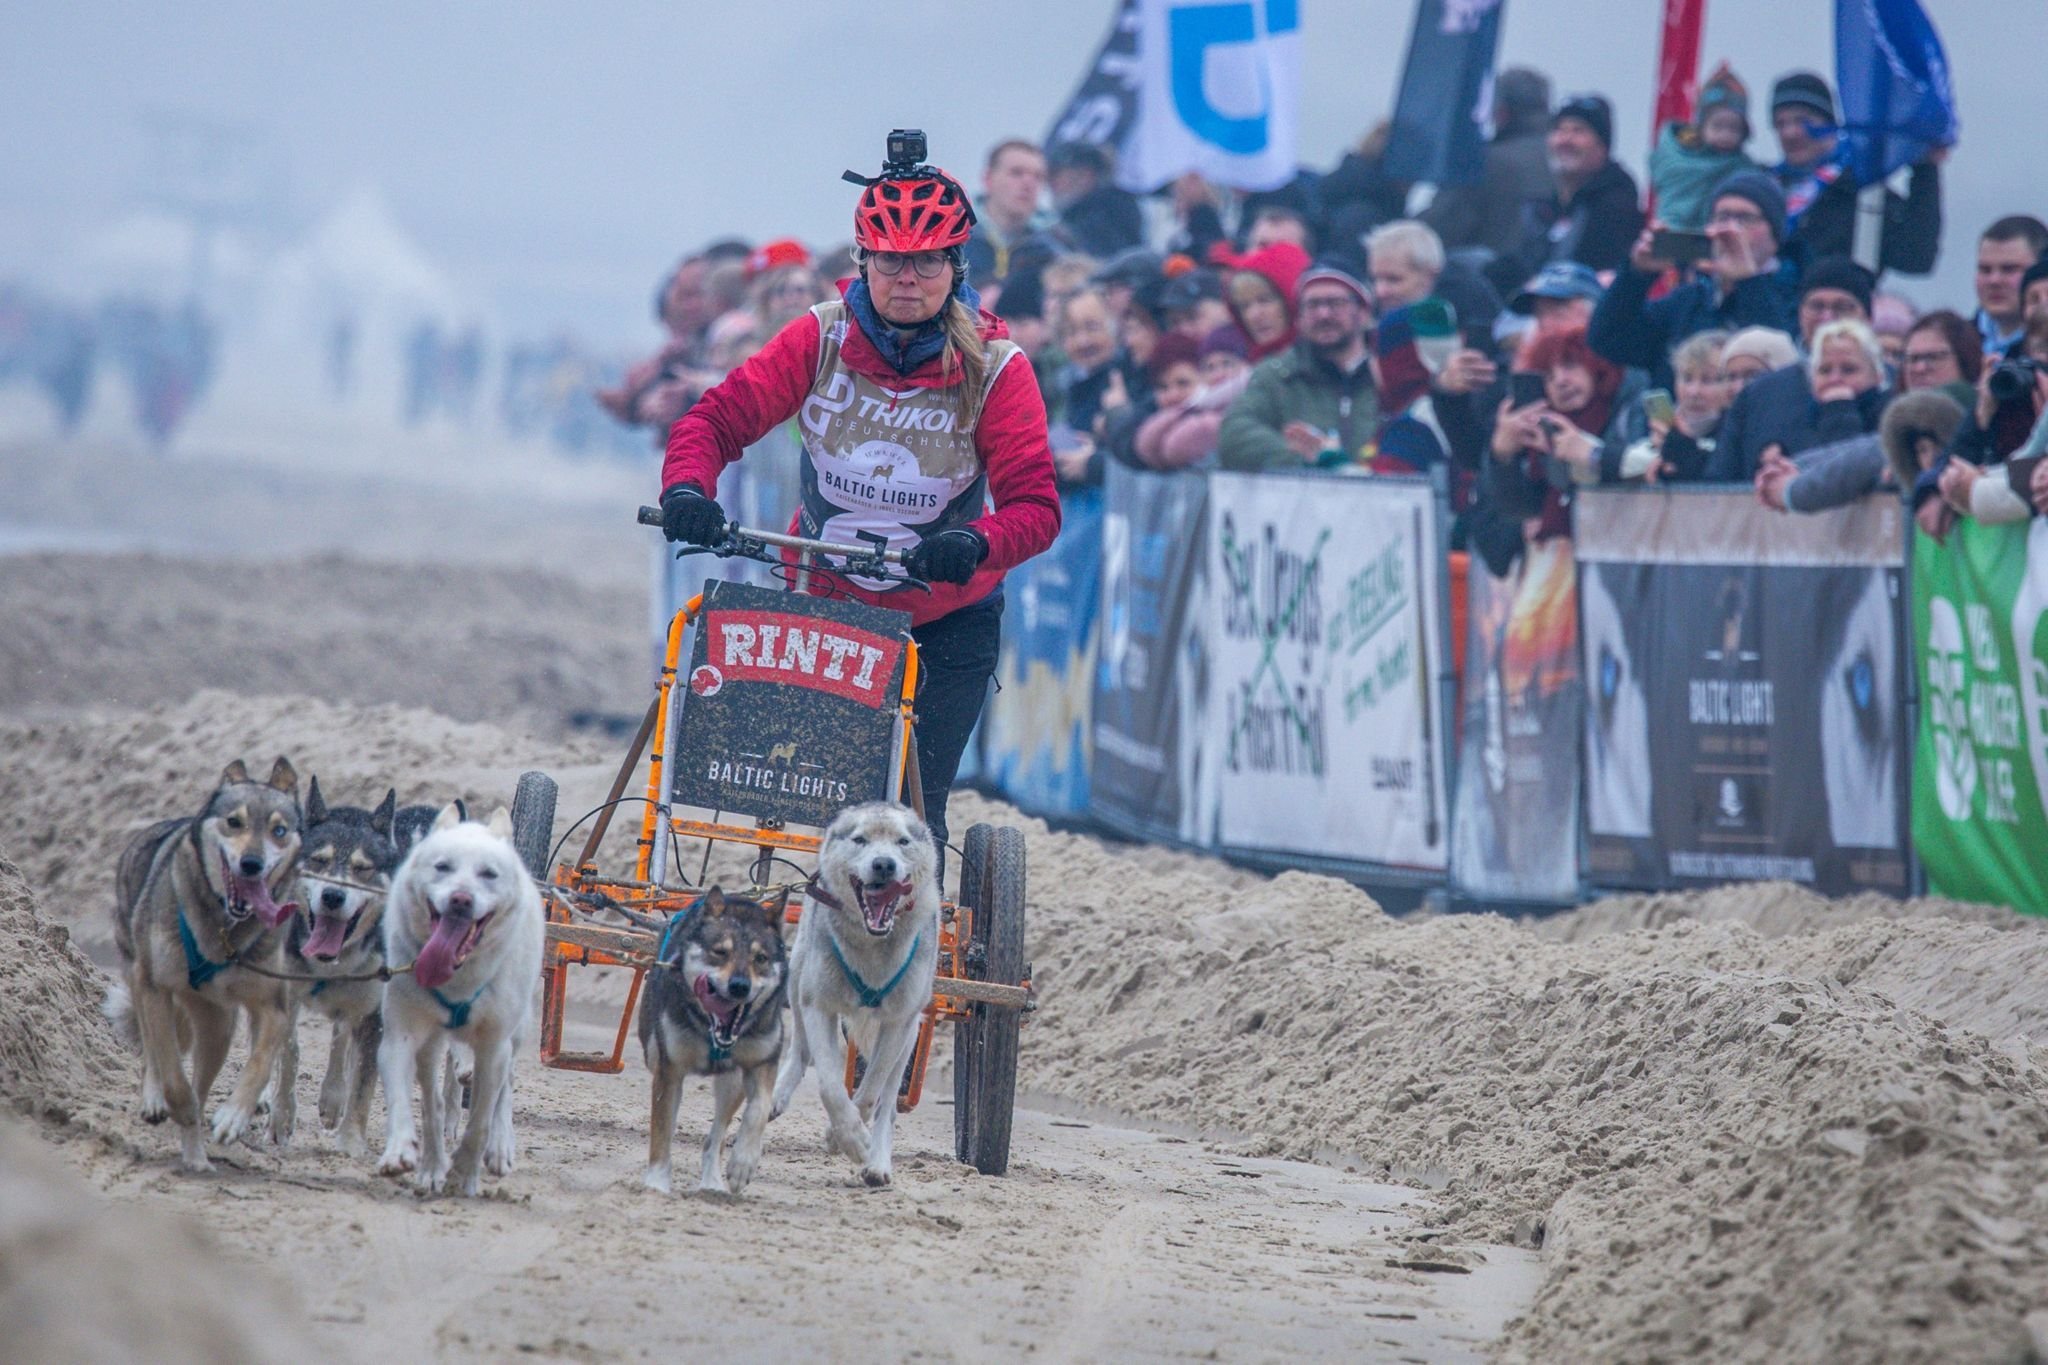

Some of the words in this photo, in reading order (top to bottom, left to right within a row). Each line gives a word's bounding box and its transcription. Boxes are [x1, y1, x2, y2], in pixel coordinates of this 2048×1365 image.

[825, 471, 876, 499] BALTIC
[881, 488, 938, 508] LIGHTS
[721, 623, 883, 691] RINTI
[708, 761, 774, 789] BALTIC
[781, 772, 847, 802] LIGHTS
